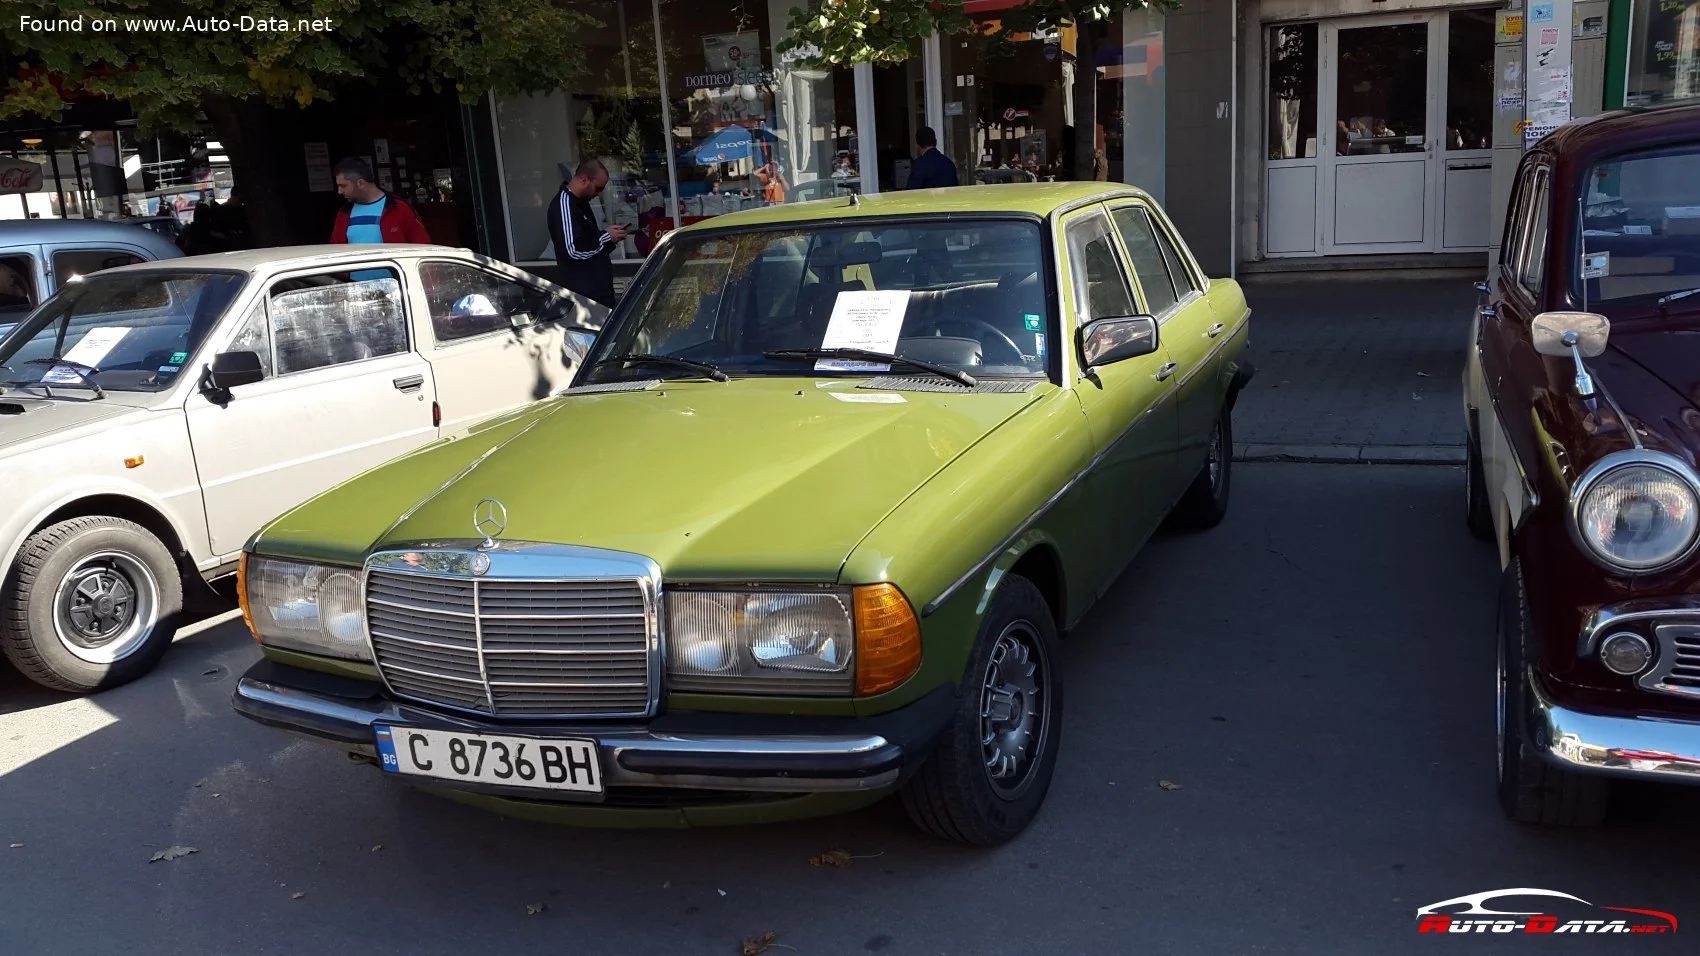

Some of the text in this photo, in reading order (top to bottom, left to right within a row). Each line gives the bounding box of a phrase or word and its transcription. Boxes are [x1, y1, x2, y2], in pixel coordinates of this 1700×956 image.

[383, 753, 397, 765] BG
[408, 734, 595, 785] C 8736 BH
